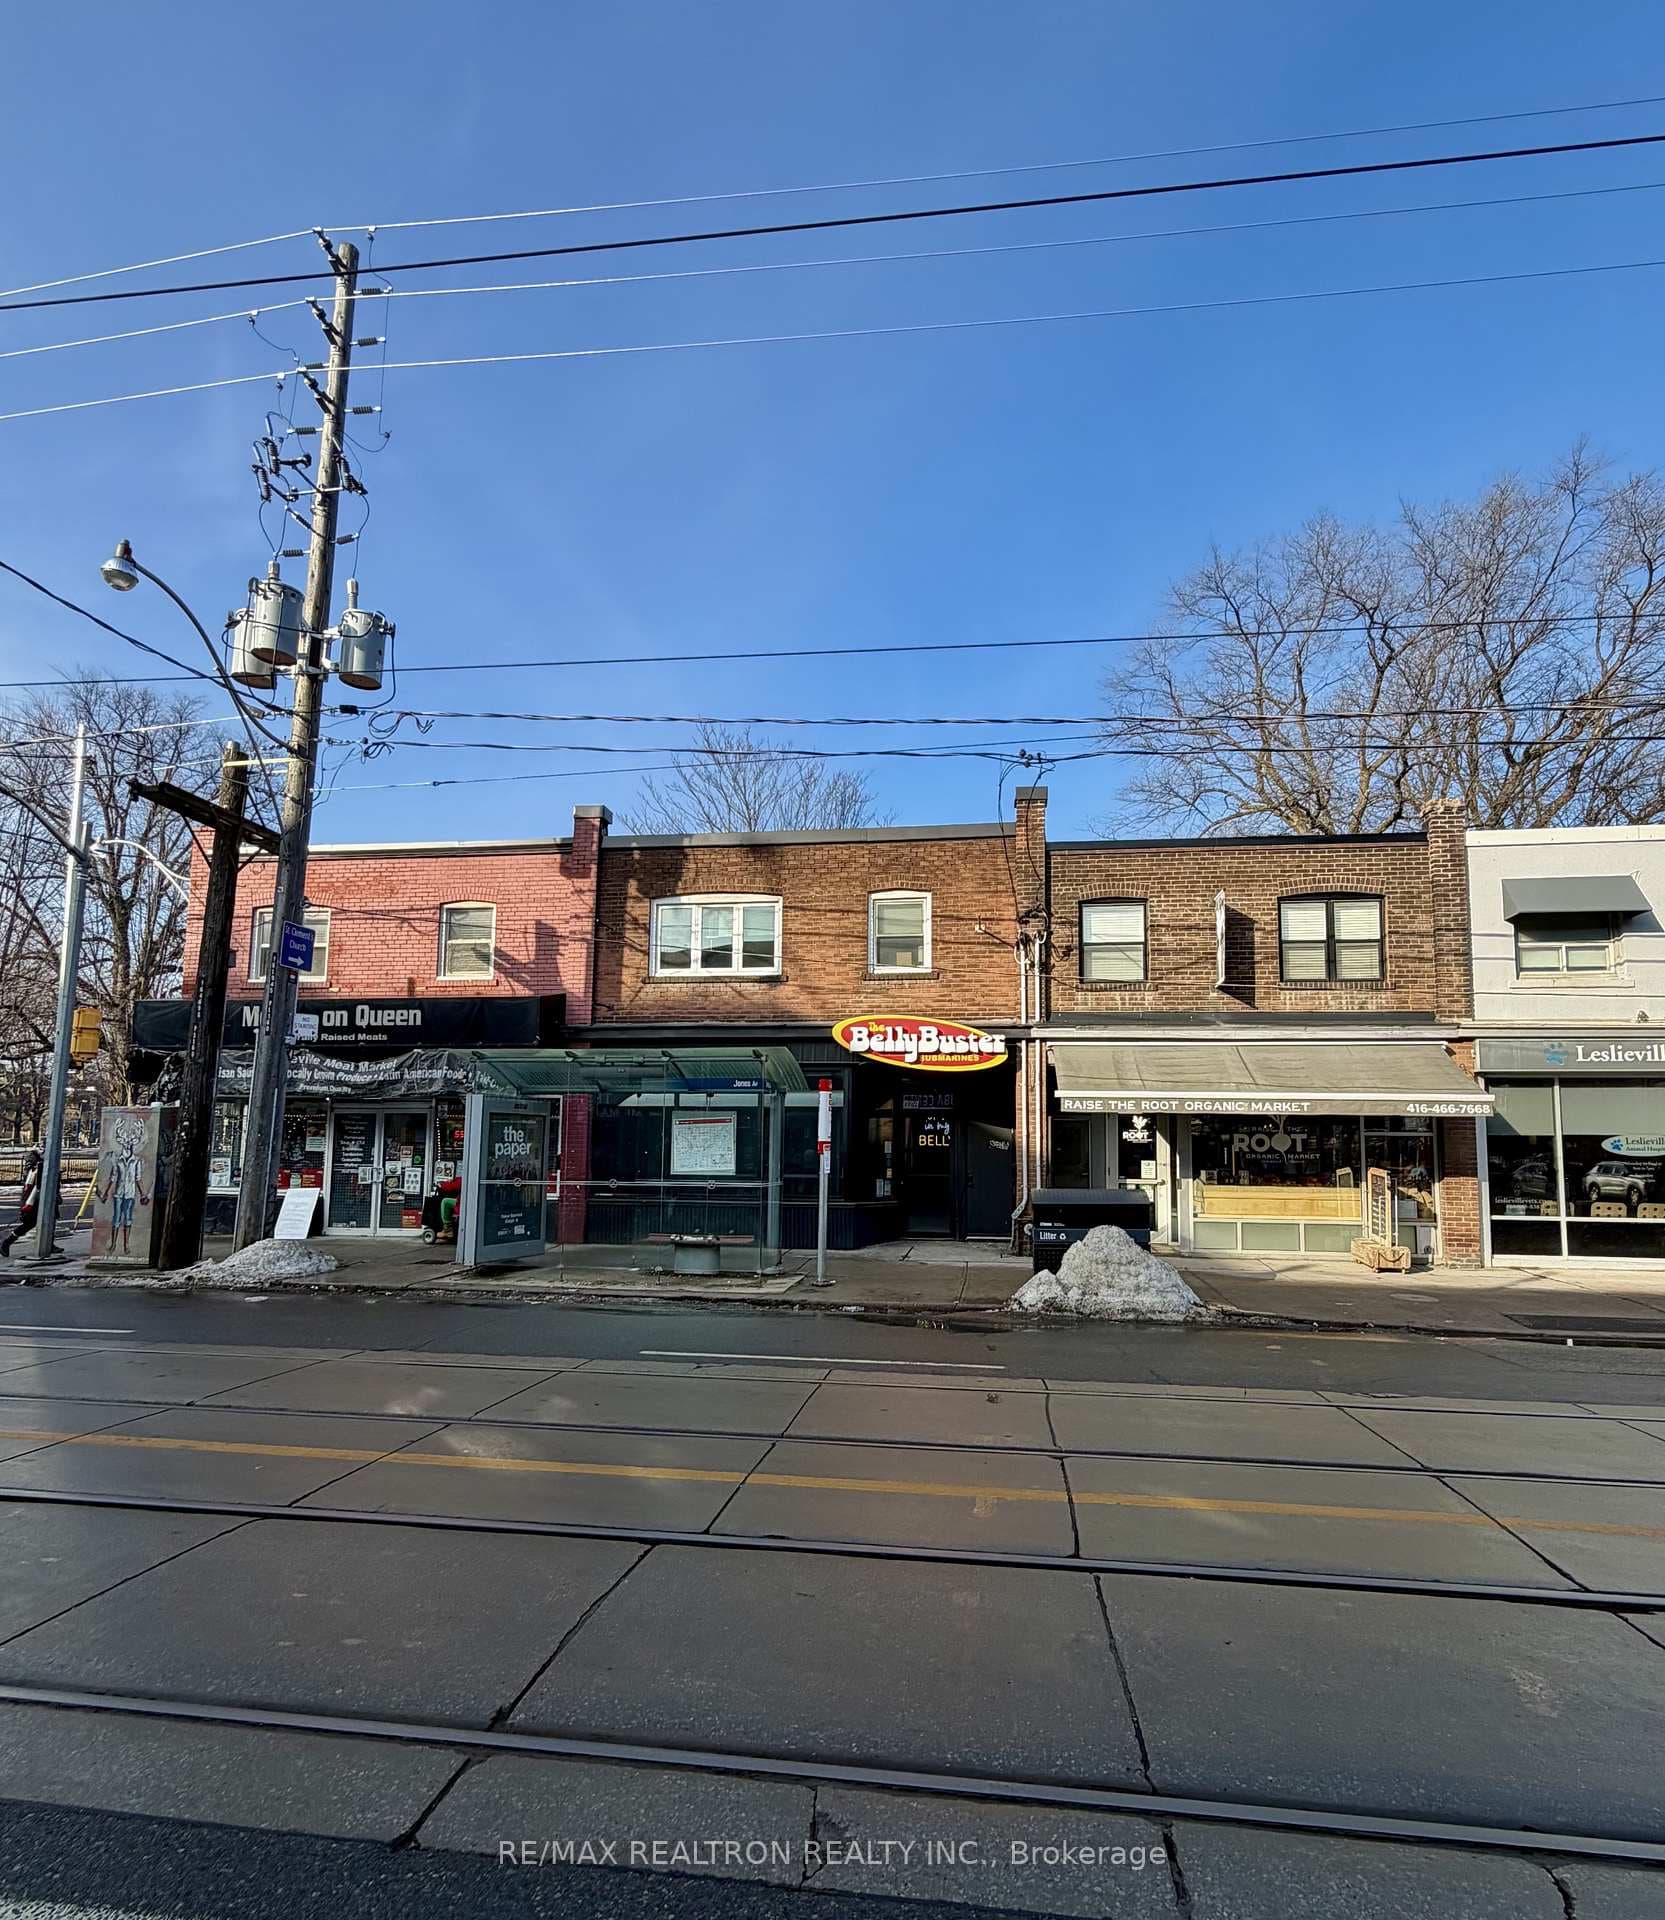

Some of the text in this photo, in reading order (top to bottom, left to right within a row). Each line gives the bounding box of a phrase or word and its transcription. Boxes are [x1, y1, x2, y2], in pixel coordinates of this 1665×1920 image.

[322, 1004, 422, 1029] on Queen
[320, 1033, 355, 1041] Raised
[357, 1033, 388, 1041] Meats
[323, 1058, 355, 1072] Meat
[287, 1067, 313, 1081] ocally
[733, 1079, 751, 1088] Jones
[1064, 1100, 1491, 1114] RAISE THE ROOT ORGANIC MARKET 416-466-7668
[503, 1125, 525, 1142] the
[918, 1134, 951, 1147] BELL
[494, 1141, 533, 1159] paper
[1039, 1231, 1057, 1240] Litter
